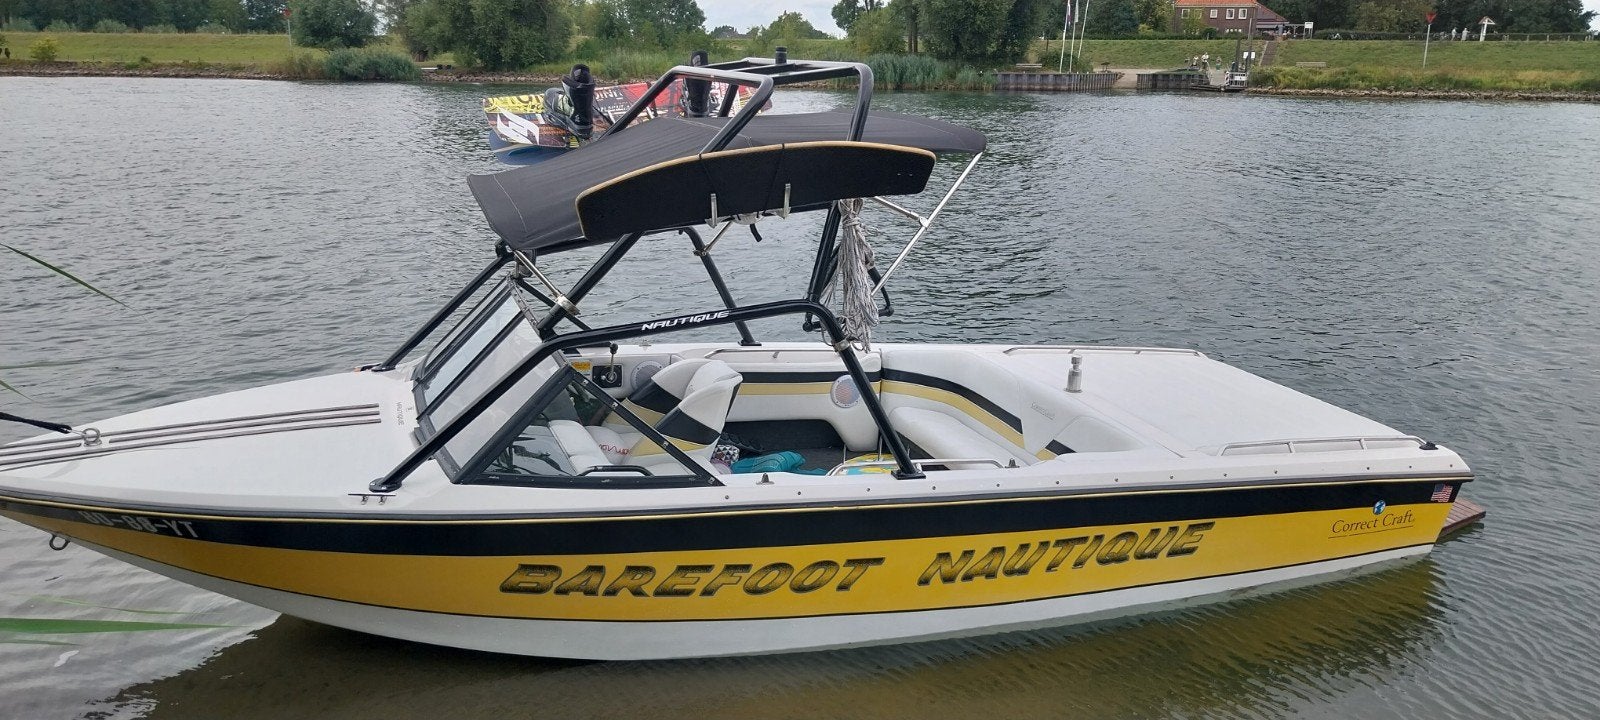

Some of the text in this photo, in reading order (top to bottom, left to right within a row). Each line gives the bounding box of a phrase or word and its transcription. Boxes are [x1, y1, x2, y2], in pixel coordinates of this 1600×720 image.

[641, 310, 730, 331] NAUTIQUE
[1331, 509, 1414, 534] Correct Craft
[499, 521, 1216, 598] BAREFOOT NAUTIQUE
